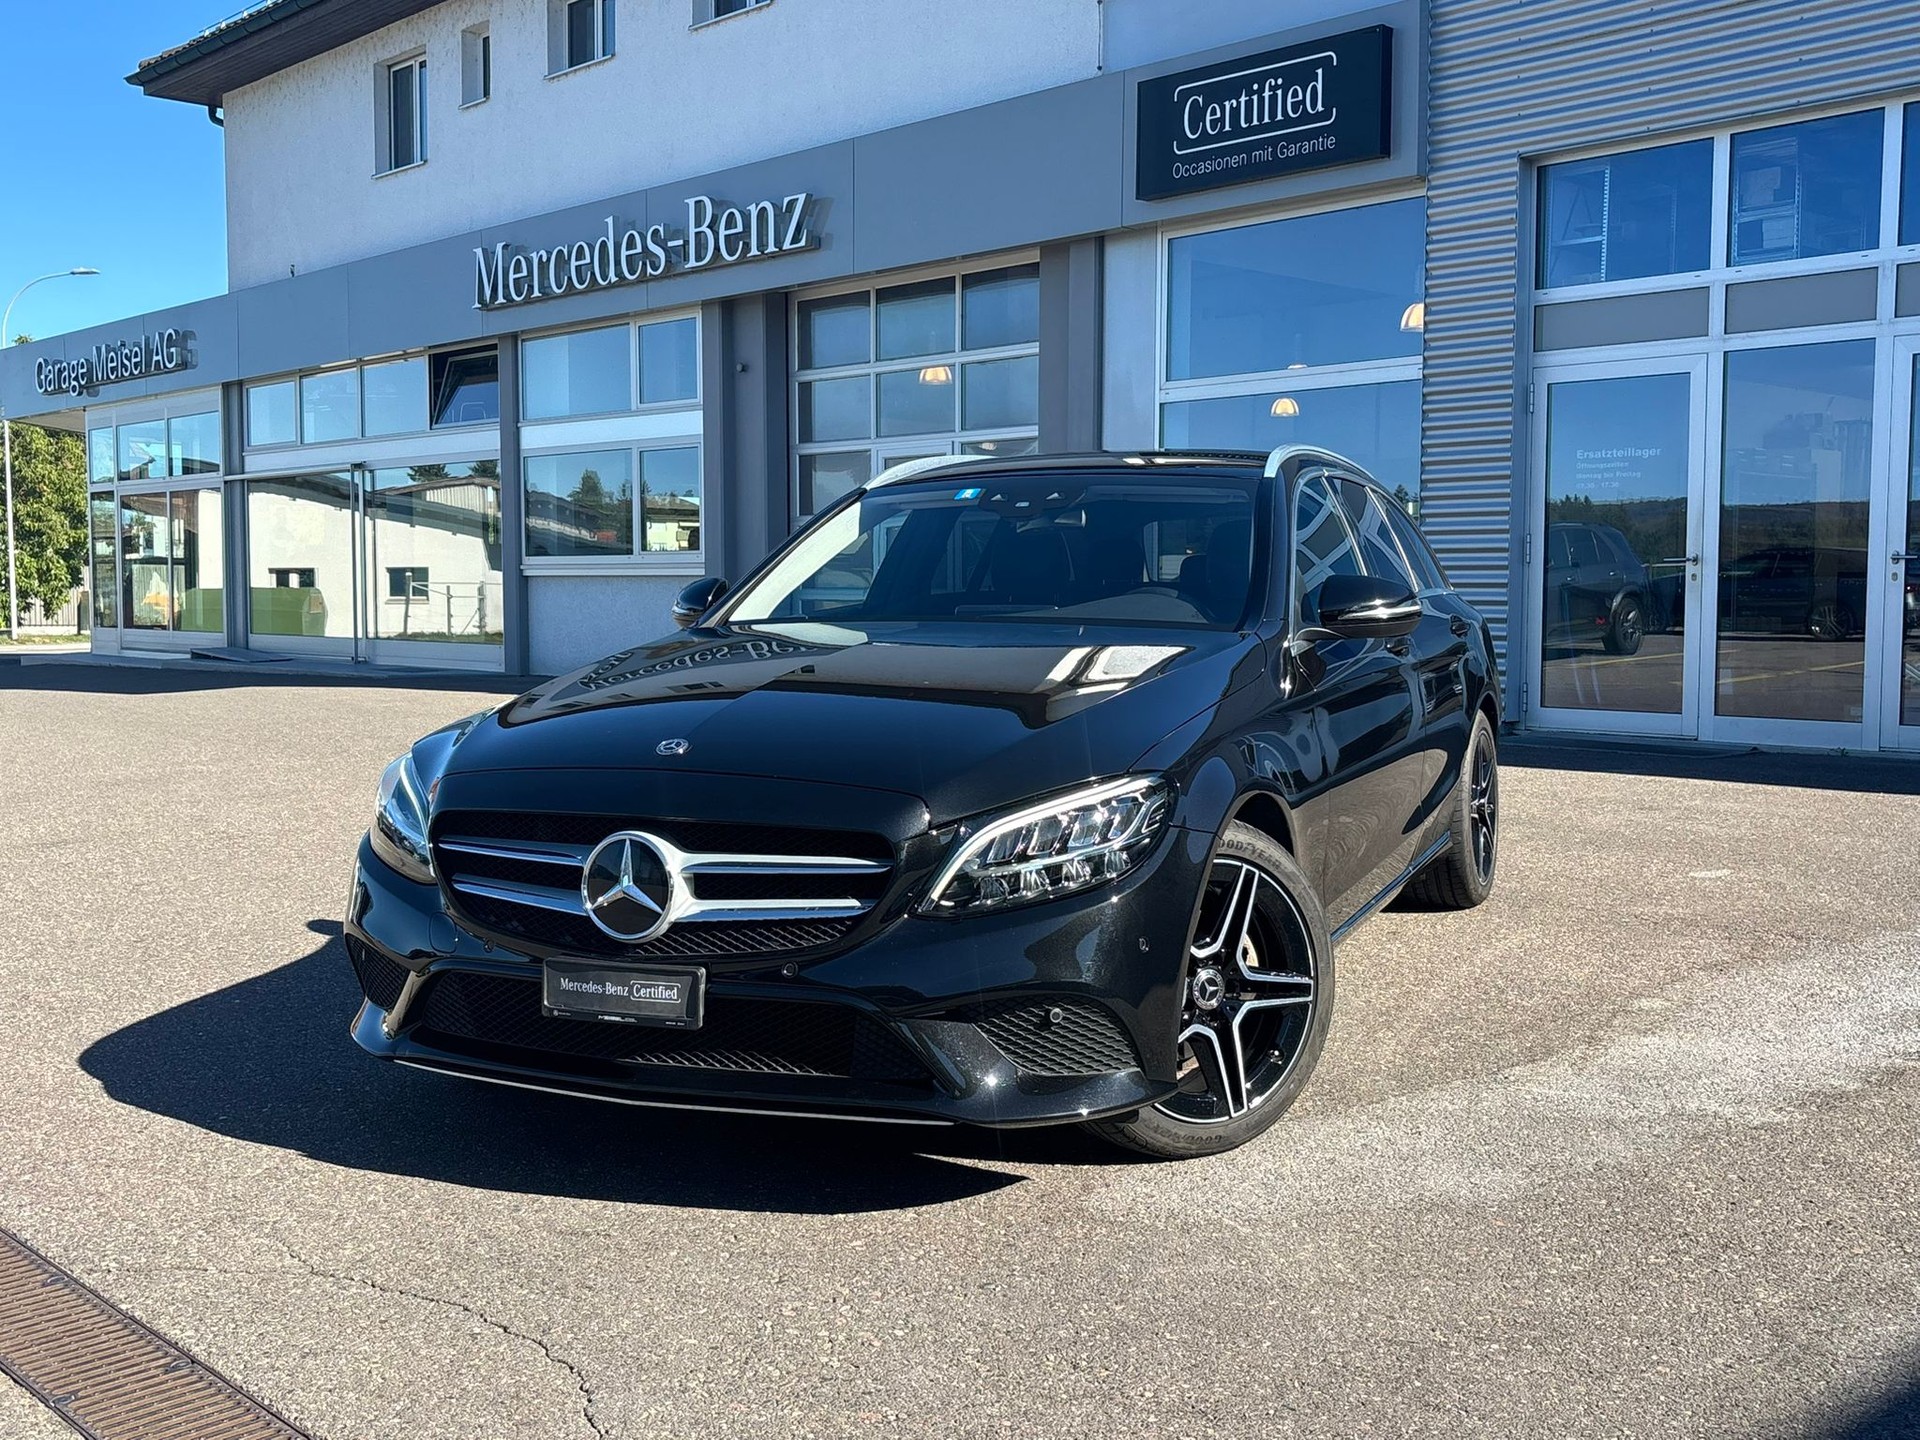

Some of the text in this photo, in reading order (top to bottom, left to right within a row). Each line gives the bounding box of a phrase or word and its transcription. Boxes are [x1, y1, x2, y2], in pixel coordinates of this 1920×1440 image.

[1184, 68, 1325, 139] Certified
[1172, 134, 1336, 179] Occasionen mit Garantie
[472, 192, 809, 310] Mercedes-Benz
[35, 328, 177, 397] Garage Meisel AG
[1576, 447, 1662, 459] Ersatzteillager
[560, 977, 678, 1000] Mercedes-Benz Certified
